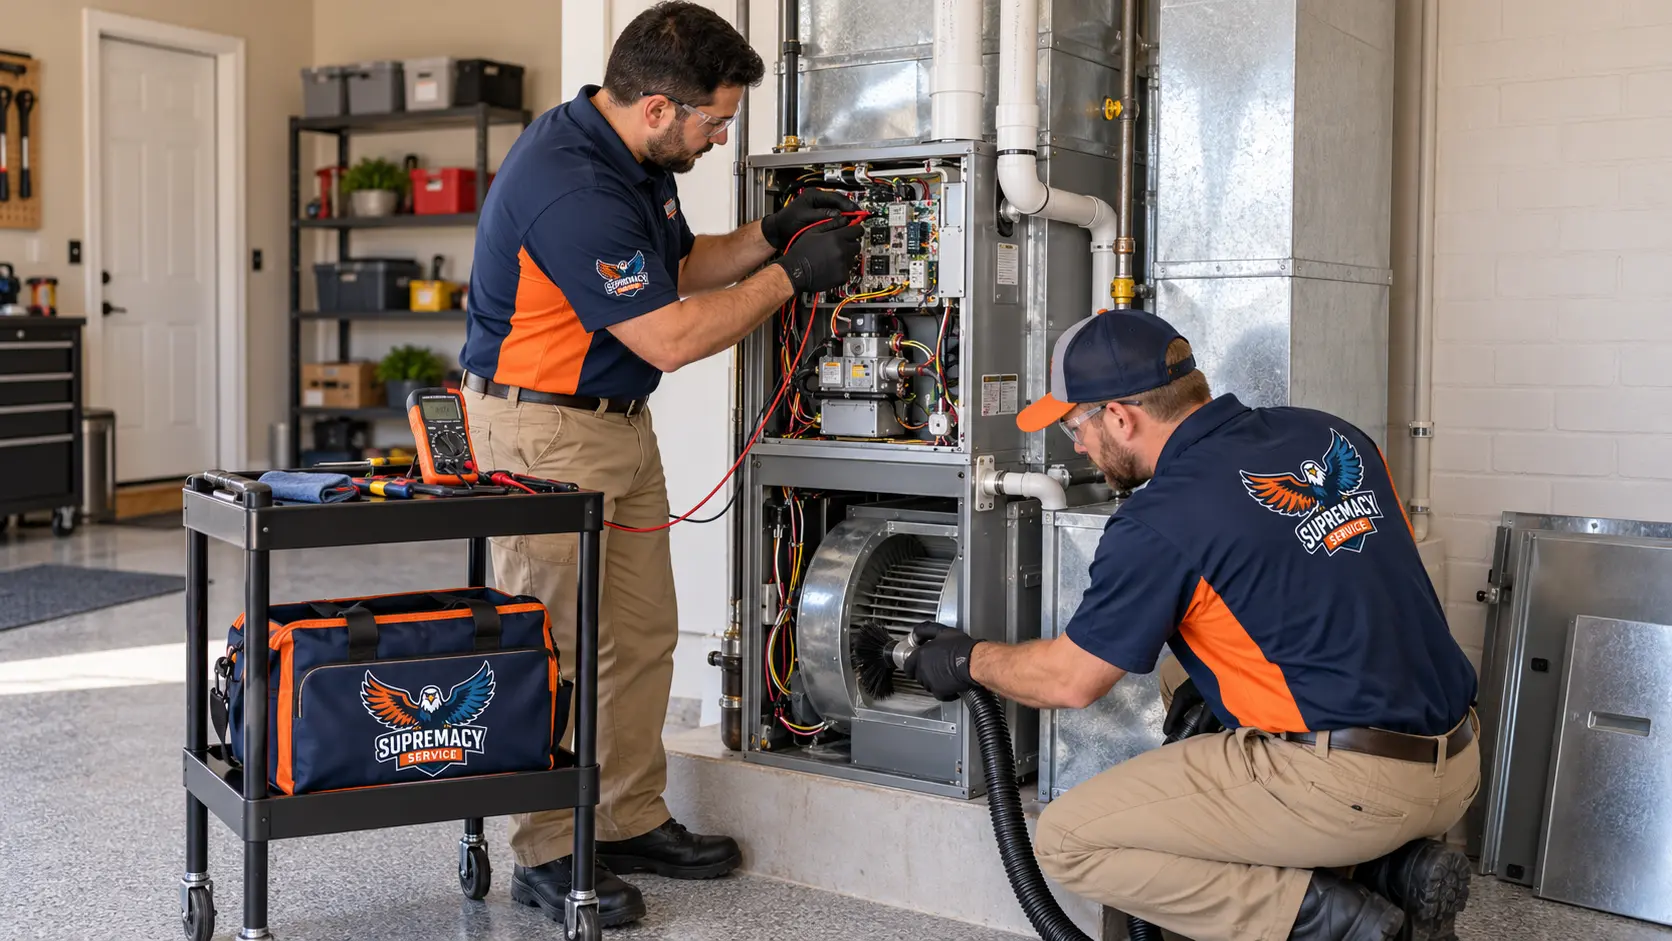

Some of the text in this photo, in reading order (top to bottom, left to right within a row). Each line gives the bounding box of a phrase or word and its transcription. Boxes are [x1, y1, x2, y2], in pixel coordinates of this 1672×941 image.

[1300, 495, 1378, 549] SUPREMACY
[1329, 520, 1368, 545] SERVICE
[379, 728, 483, 758] SUPREMACY
[407, 749, 457, 763] SERVICE
